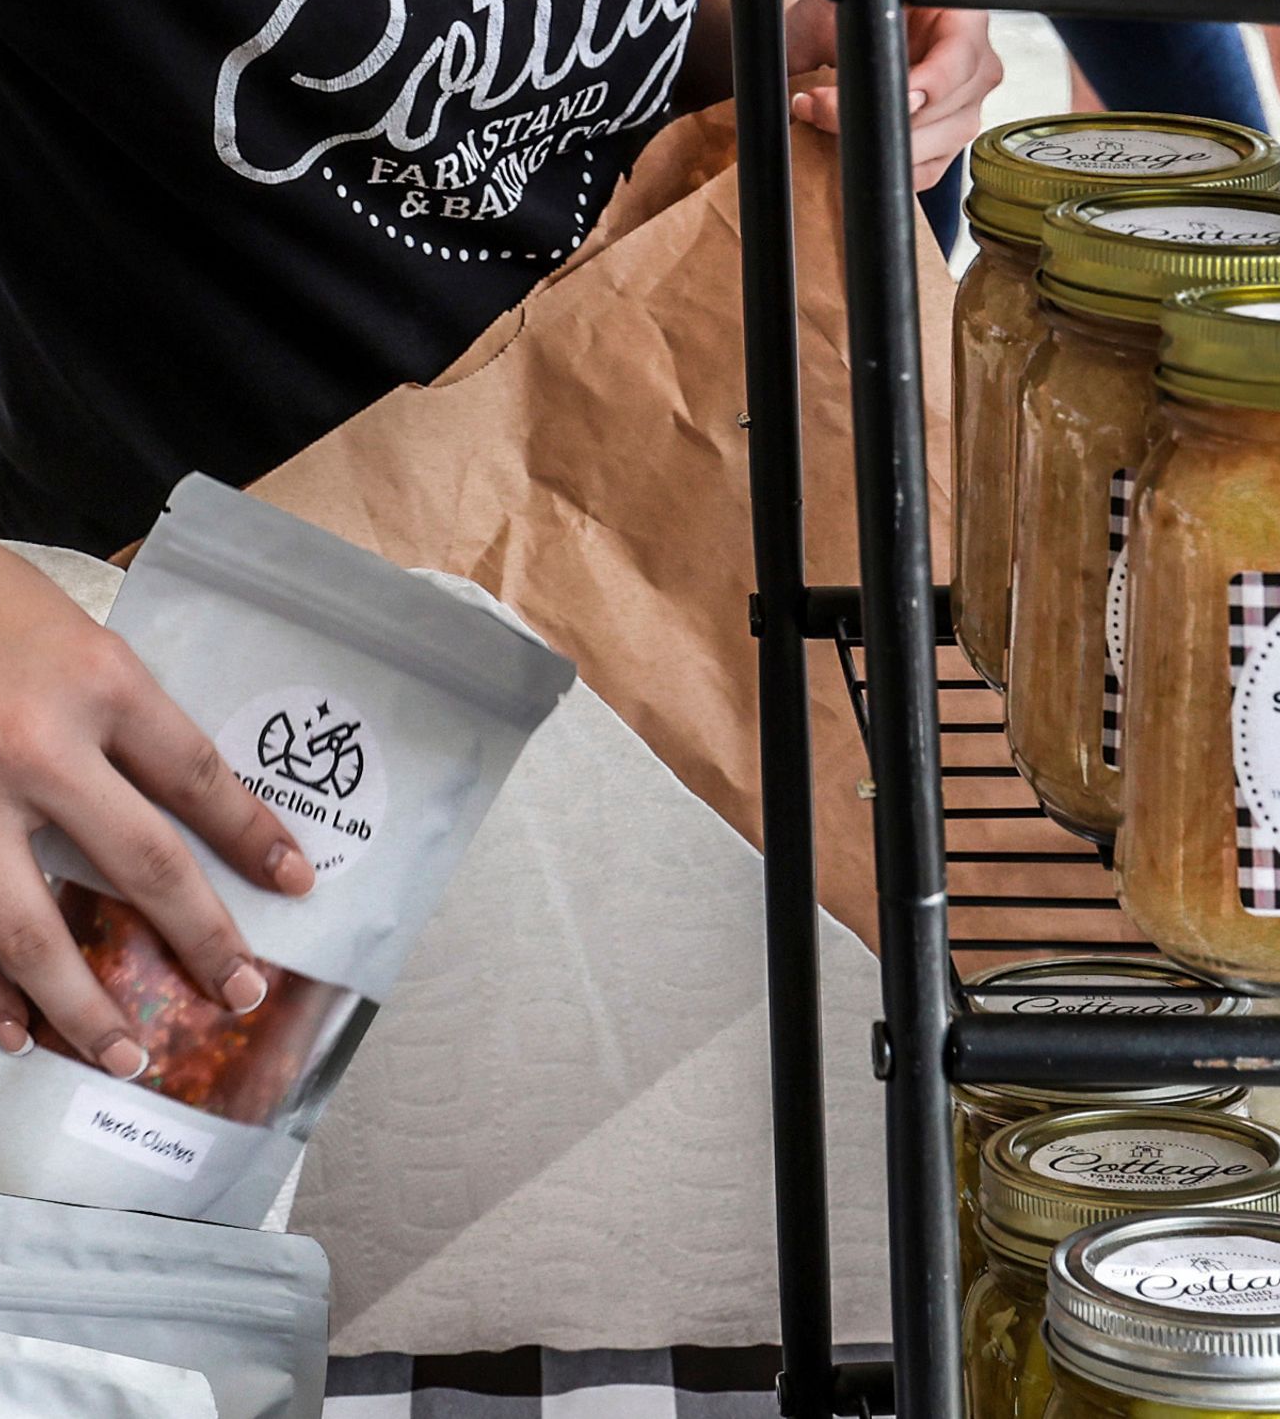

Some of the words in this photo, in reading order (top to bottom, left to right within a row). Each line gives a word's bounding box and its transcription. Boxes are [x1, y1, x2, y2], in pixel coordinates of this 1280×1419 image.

[1026, 145, 1213, 170] Cottage
[400, 190, 430, 218] &
[233, 771, 327, 824] nfection
[332, 809, 372, 841] Lab
[90, 1110, 139, 1142] Nerds
[141, 1130, 196, 1164] Clusters
[1047, 1142, 1086, 1153] The
[1049, 1152, 1253, 1185] Cottage
